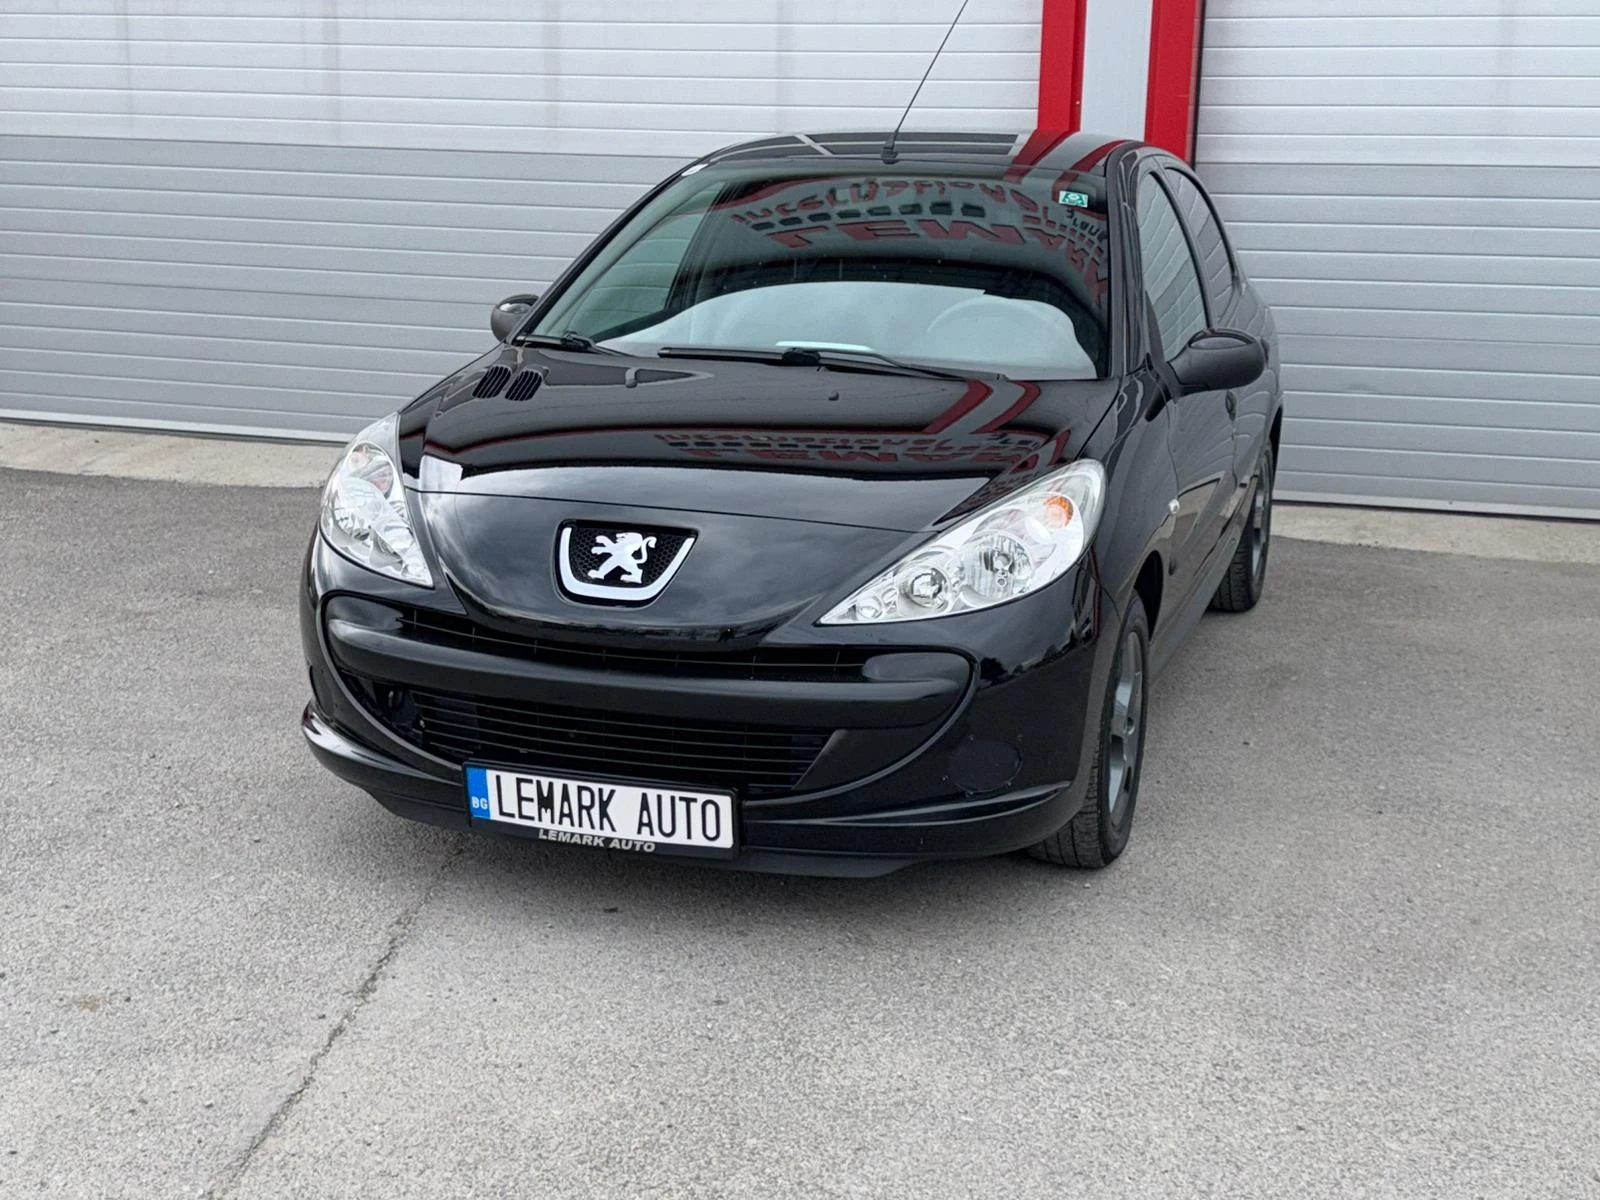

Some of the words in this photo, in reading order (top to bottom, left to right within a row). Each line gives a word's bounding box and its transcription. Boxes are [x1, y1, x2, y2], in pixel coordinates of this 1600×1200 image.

[471, 796, 488, 810] BG
[495, 774, 617, 832] LEMARK
[637, 792, 721, 842] AUTO
[538, 828, 605, 848] LEMARK
[609, 839, 656, 853] AUTO
